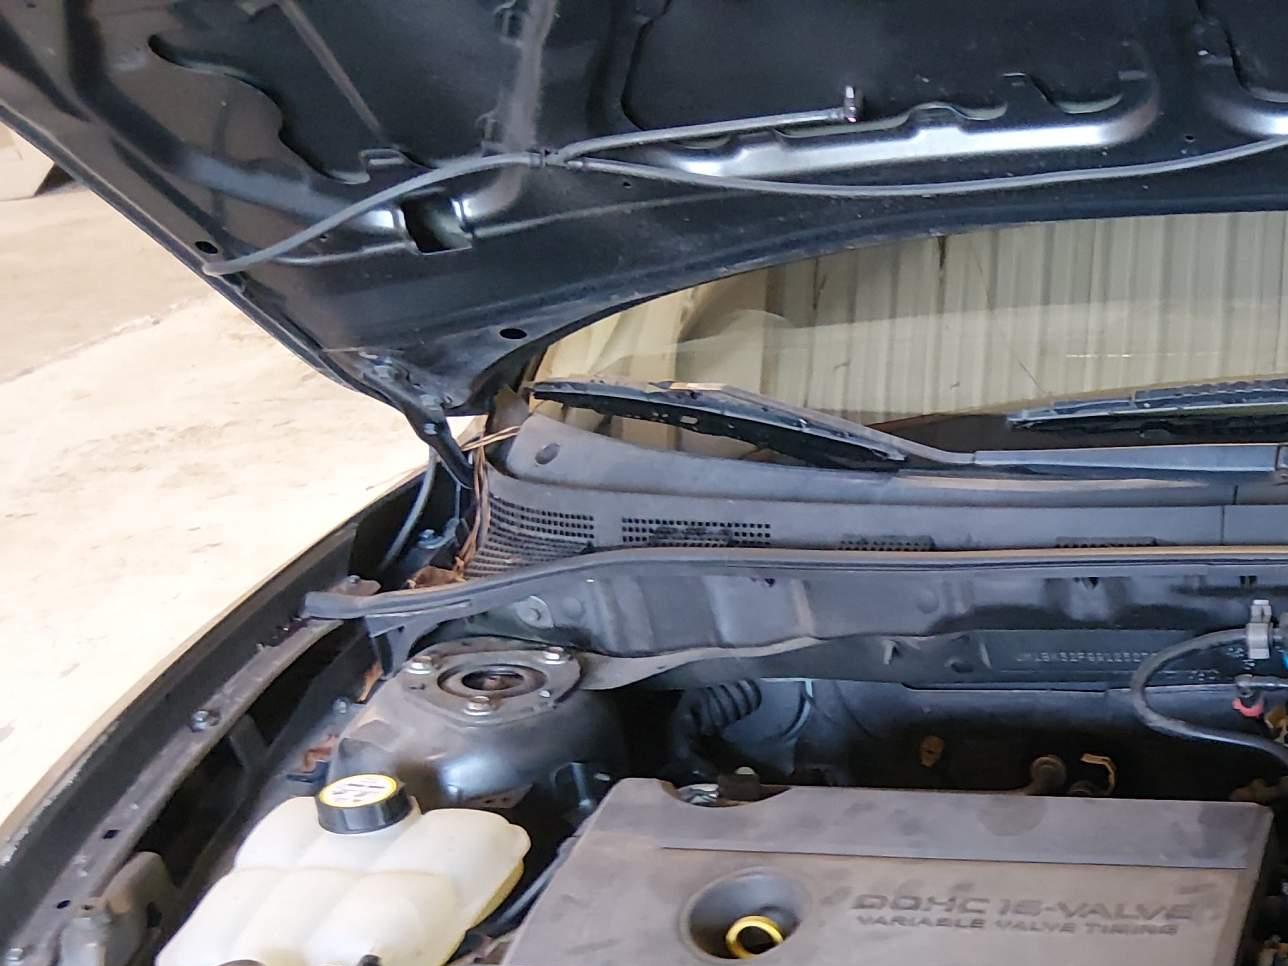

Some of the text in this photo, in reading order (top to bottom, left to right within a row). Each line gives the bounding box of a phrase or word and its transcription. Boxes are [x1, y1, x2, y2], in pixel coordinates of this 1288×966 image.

[851, 894, 1195, 920] DOHC 16-VALVE
[856, 915, 1179, 936] VARIABLE VALVE TIMING
